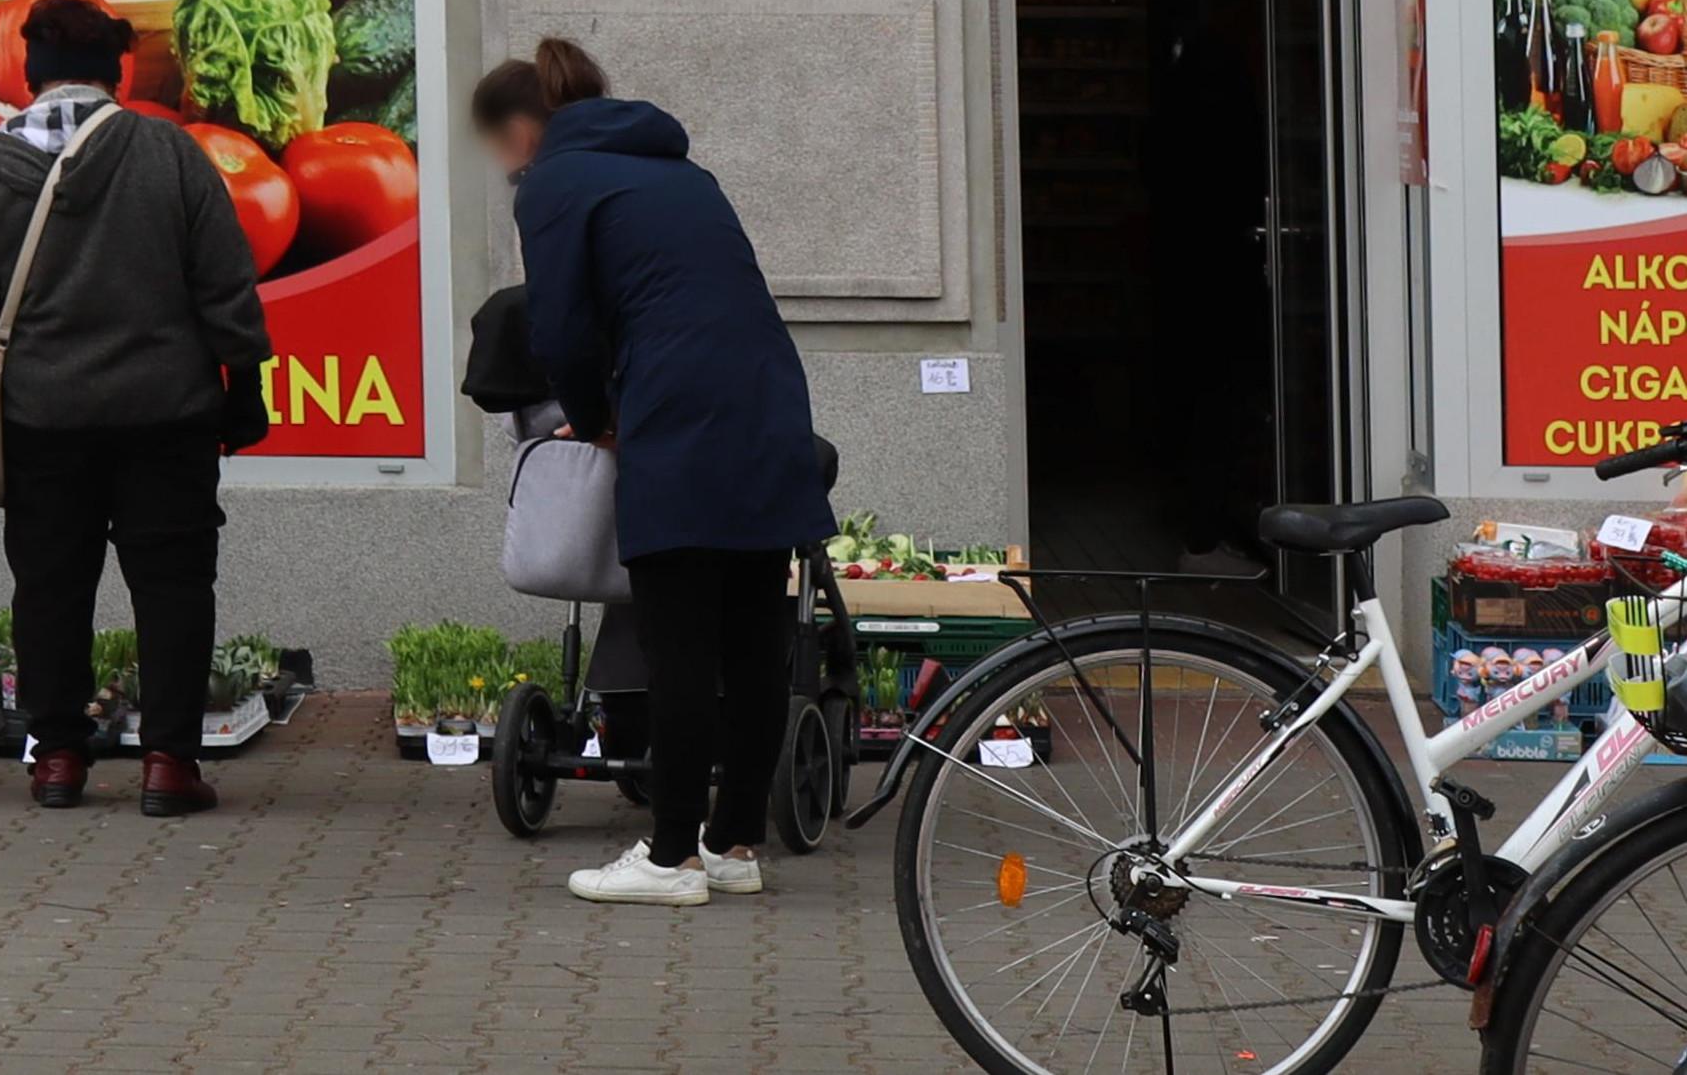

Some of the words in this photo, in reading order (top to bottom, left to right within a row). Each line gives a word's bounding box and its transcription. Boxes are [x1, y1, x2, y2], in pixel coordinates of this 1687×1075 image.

[1544, 419, 1674, 455] CUKR
[1462, 654, 1581, 731] MERCURY
[1497, 745, 1549, 759] bubble
